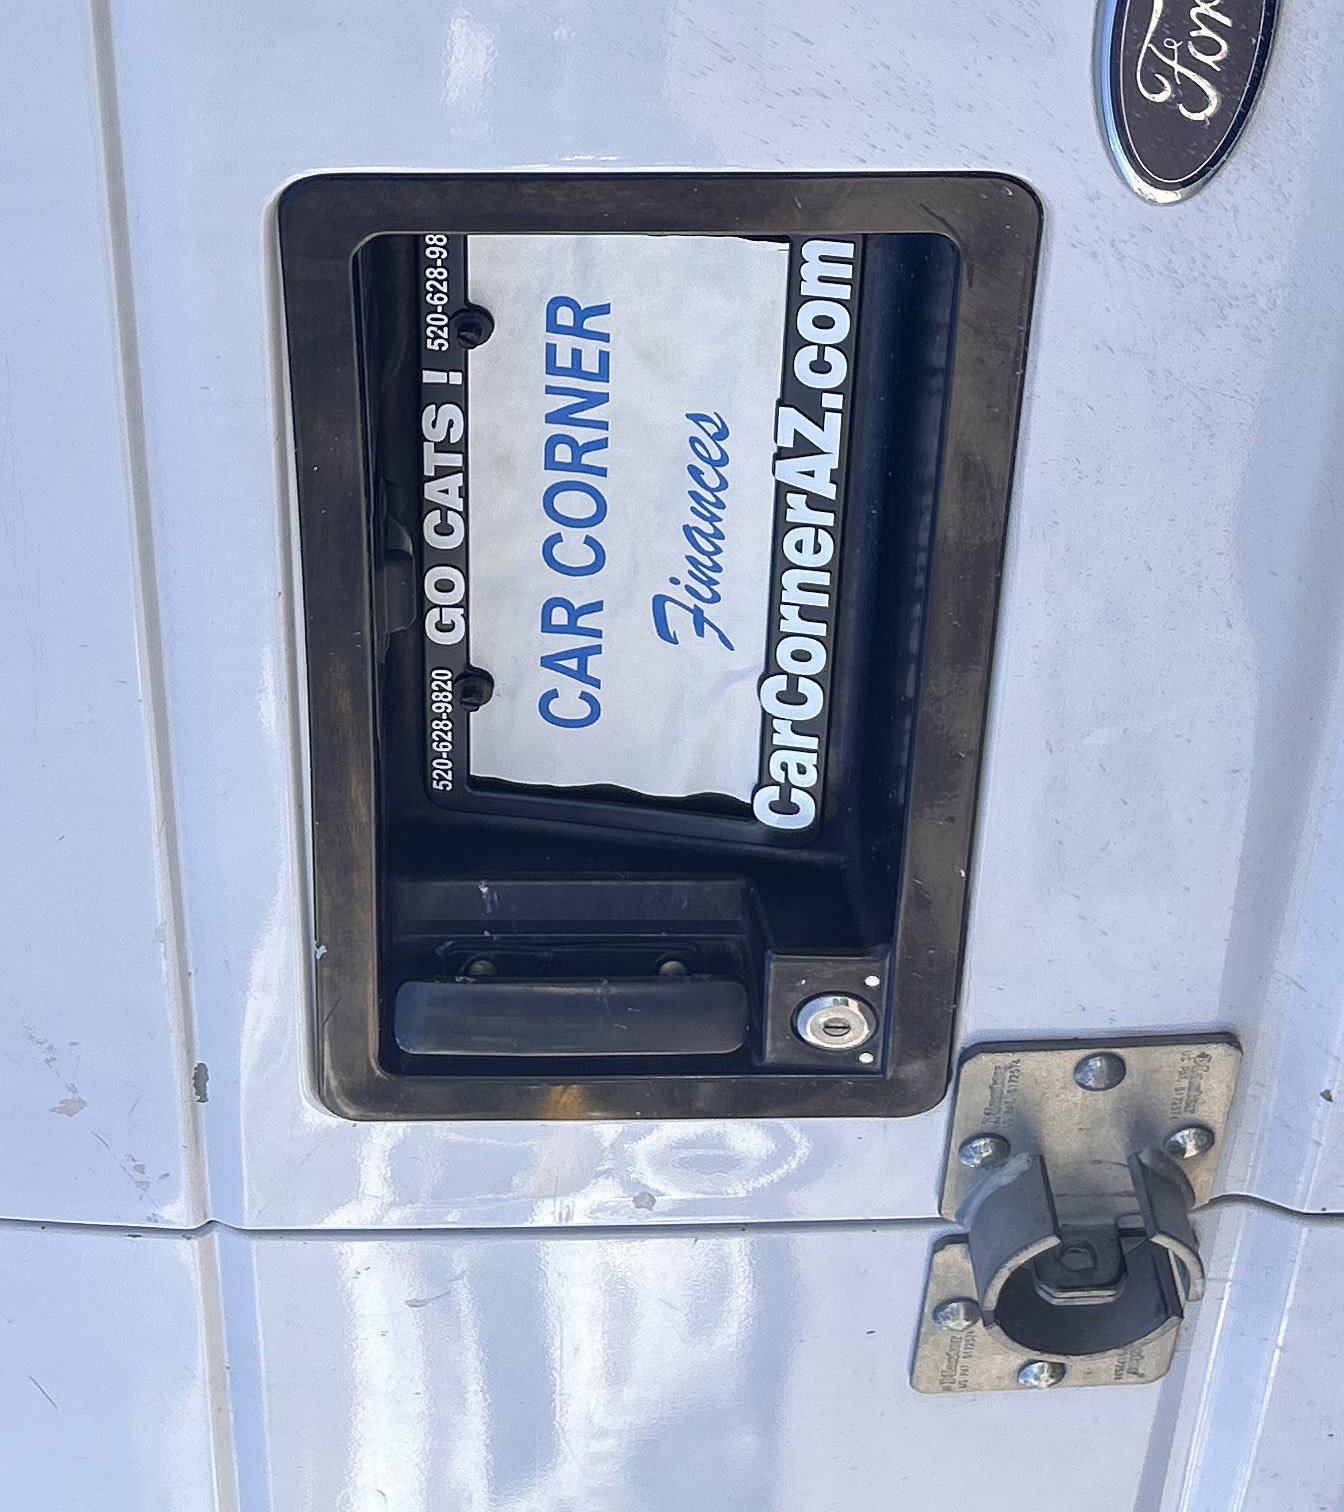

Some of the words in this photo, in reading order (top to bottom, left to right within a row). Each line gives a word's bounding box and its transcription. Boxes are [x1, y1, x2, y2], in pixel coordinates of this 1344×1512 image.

[423, 402, 465, 551] CATS
[541, 295, 612, 578] CORNER
[423, 565, 465, 645] GO
[651, 411, 734, 652] Finances
[752, 240, 857, 831] CarCornerAZ.com
[431, 669, 453, 792] 520-628-9820
[537, 595, 605, 730] CAR
